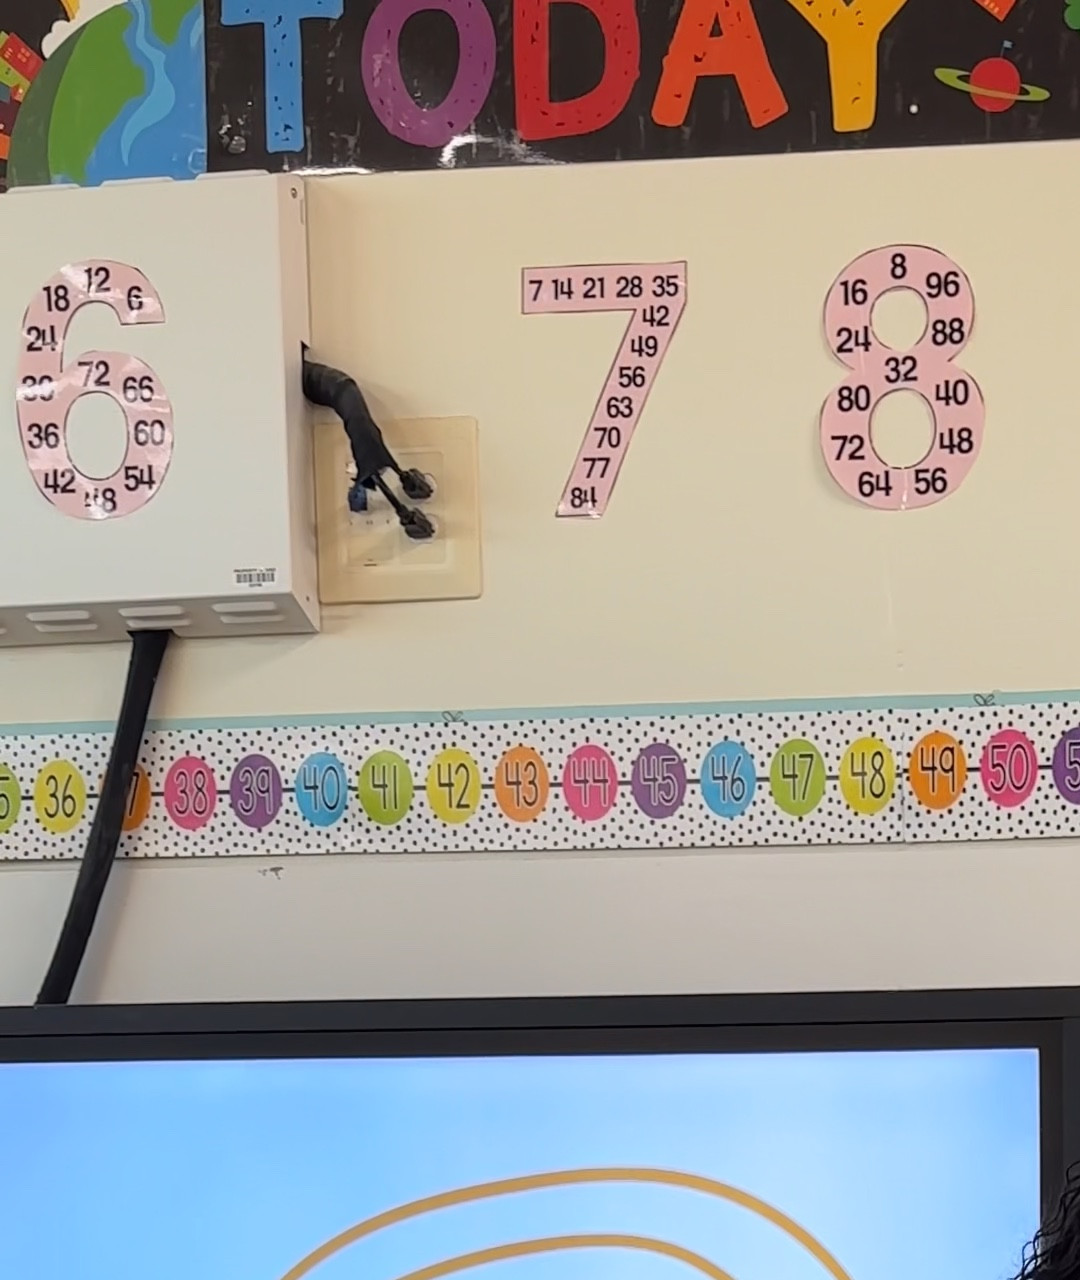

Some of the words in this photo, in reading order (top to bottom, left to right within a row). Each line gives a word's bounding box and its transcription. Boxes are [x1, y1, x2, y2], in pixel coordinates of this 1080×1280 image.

[220, 0, 905, 153] TODAY
[891, 253, 906, 279] 8
[84, 267, 111, 293] 12
[529, 280, 542, 301] 7
[552, 278, 573, 300] 14
[583, 277, 604, 298] 21
[616, 276, 642, 297] 28
[652, 275, 679, 297] 35
[926, 271, 960, 298] 96
[43, 285, 70, 312] 18
[127, 286, 142, 310] 6
[837, 326, 871, 353] 24
[78, 361, 110, 386] 72
[619, 367, 645, 387] 56
[885, 356, 917, 382] 32
[936, 379, 969, 406] 40
[27, 423, 59, 448] 36
[124, 465, 155, 491] 54
[859, 471, 892, 497] 64
[45, 775, 76, 818] 36
[173, 770, 207, 817] 38
[238, 765, 274, 817] 39
[302, 764, 341, 811] 40
[370, 763, 398, 811] 41
[436, 763, 470, 810] 42
[505, 761, 538, 808] 43
[572, 757, 611, 807] 44
[639, 756, 679, 807] 45
[711, 754, 745, 802] 46
[781, 753, 814, 802] 47
[850, 750, 886, 799] 48
[919, 746, 957, 795] 49
[989, 743, 1030, 793] 50
